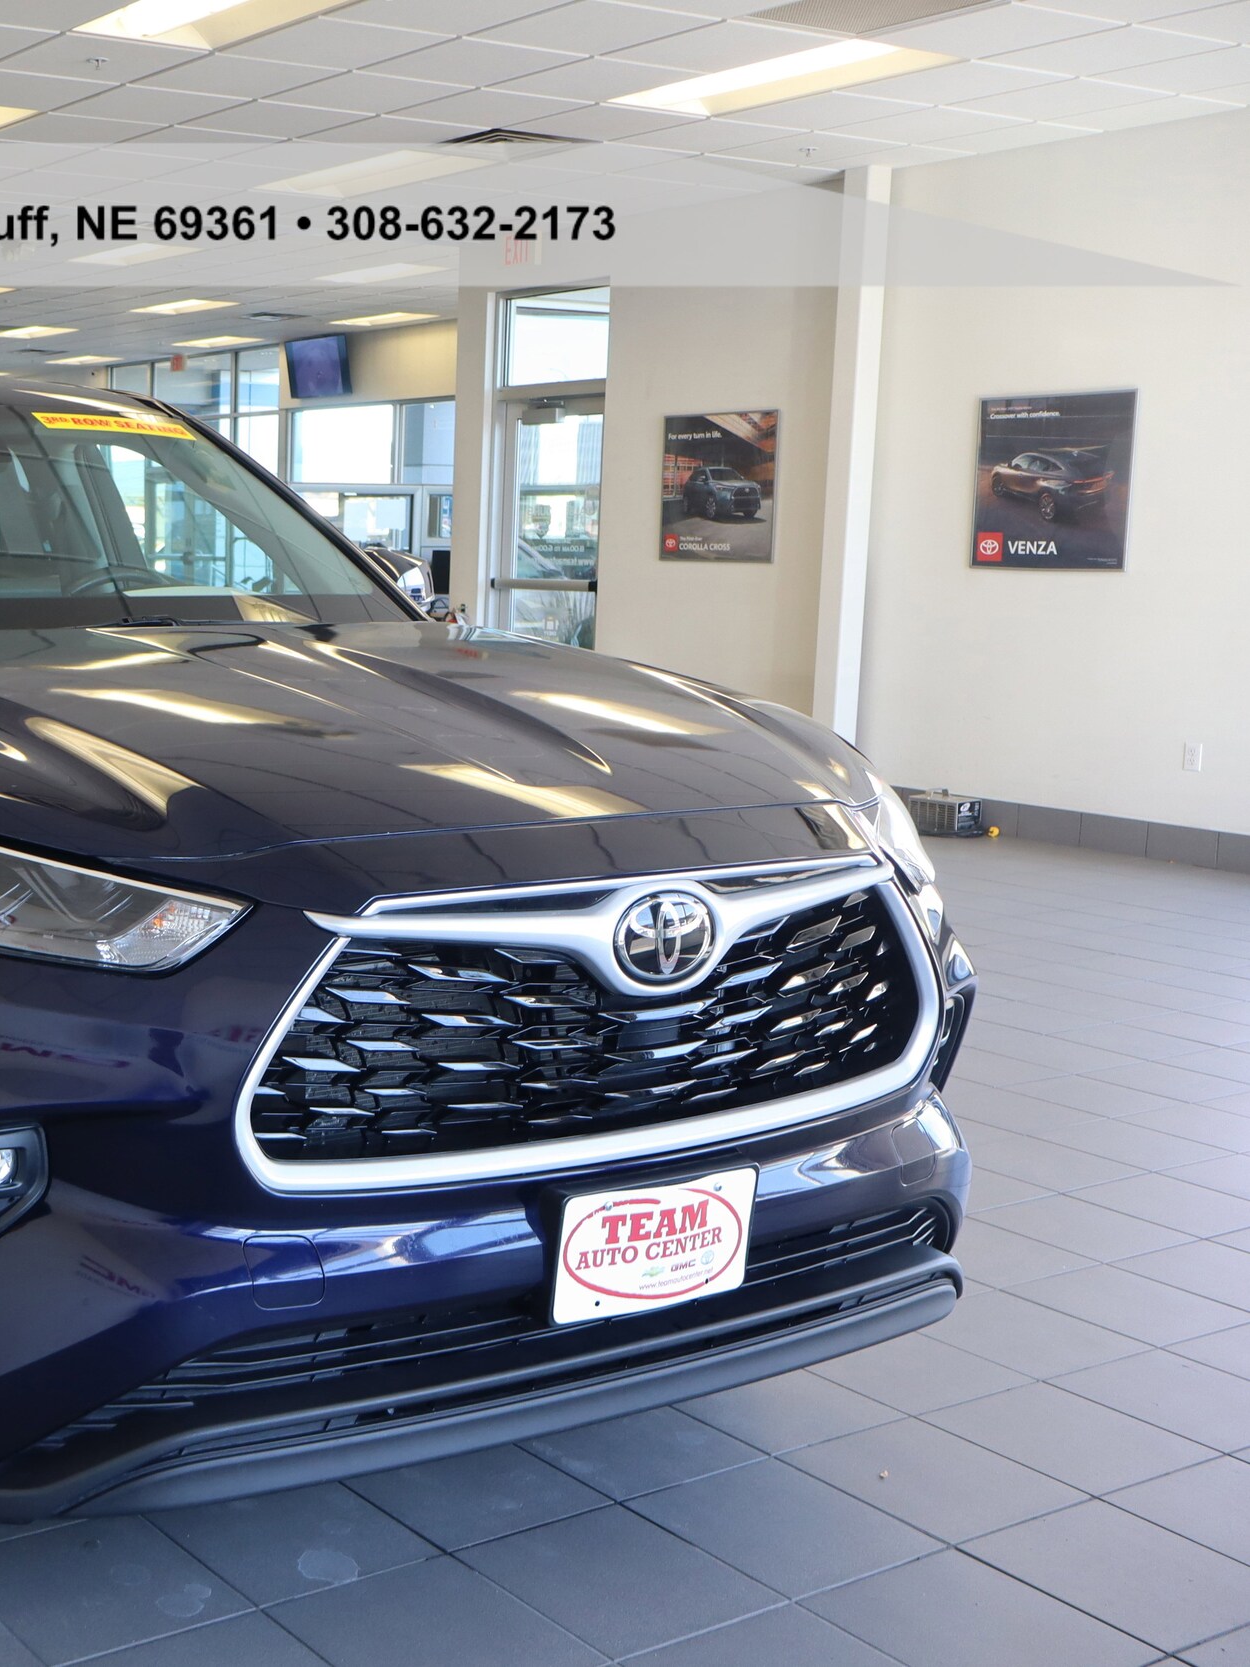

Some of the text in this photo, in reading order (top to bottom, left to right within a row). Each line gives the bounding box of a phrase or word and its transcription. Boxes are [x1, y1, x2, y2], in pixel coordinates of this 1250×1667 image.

[504, 235, 530, 266] EXIT
[70, 417, 111, 428] ROW
[113, 420, 188, 436] SEATING
[668, 432, 678, 440] For
[677, 433, 693, 441] every
[711, 430, 723, 439] life.
[678, 543, 731, 551] COROLLA CROSS
[1007, 540, 1058, 556] VENZA
[601, 1198, 710, 1245] TEAM
[575, 1226, 723, 1271] AUTO CENTER
[670, 1258, 697, 1273] GMC
